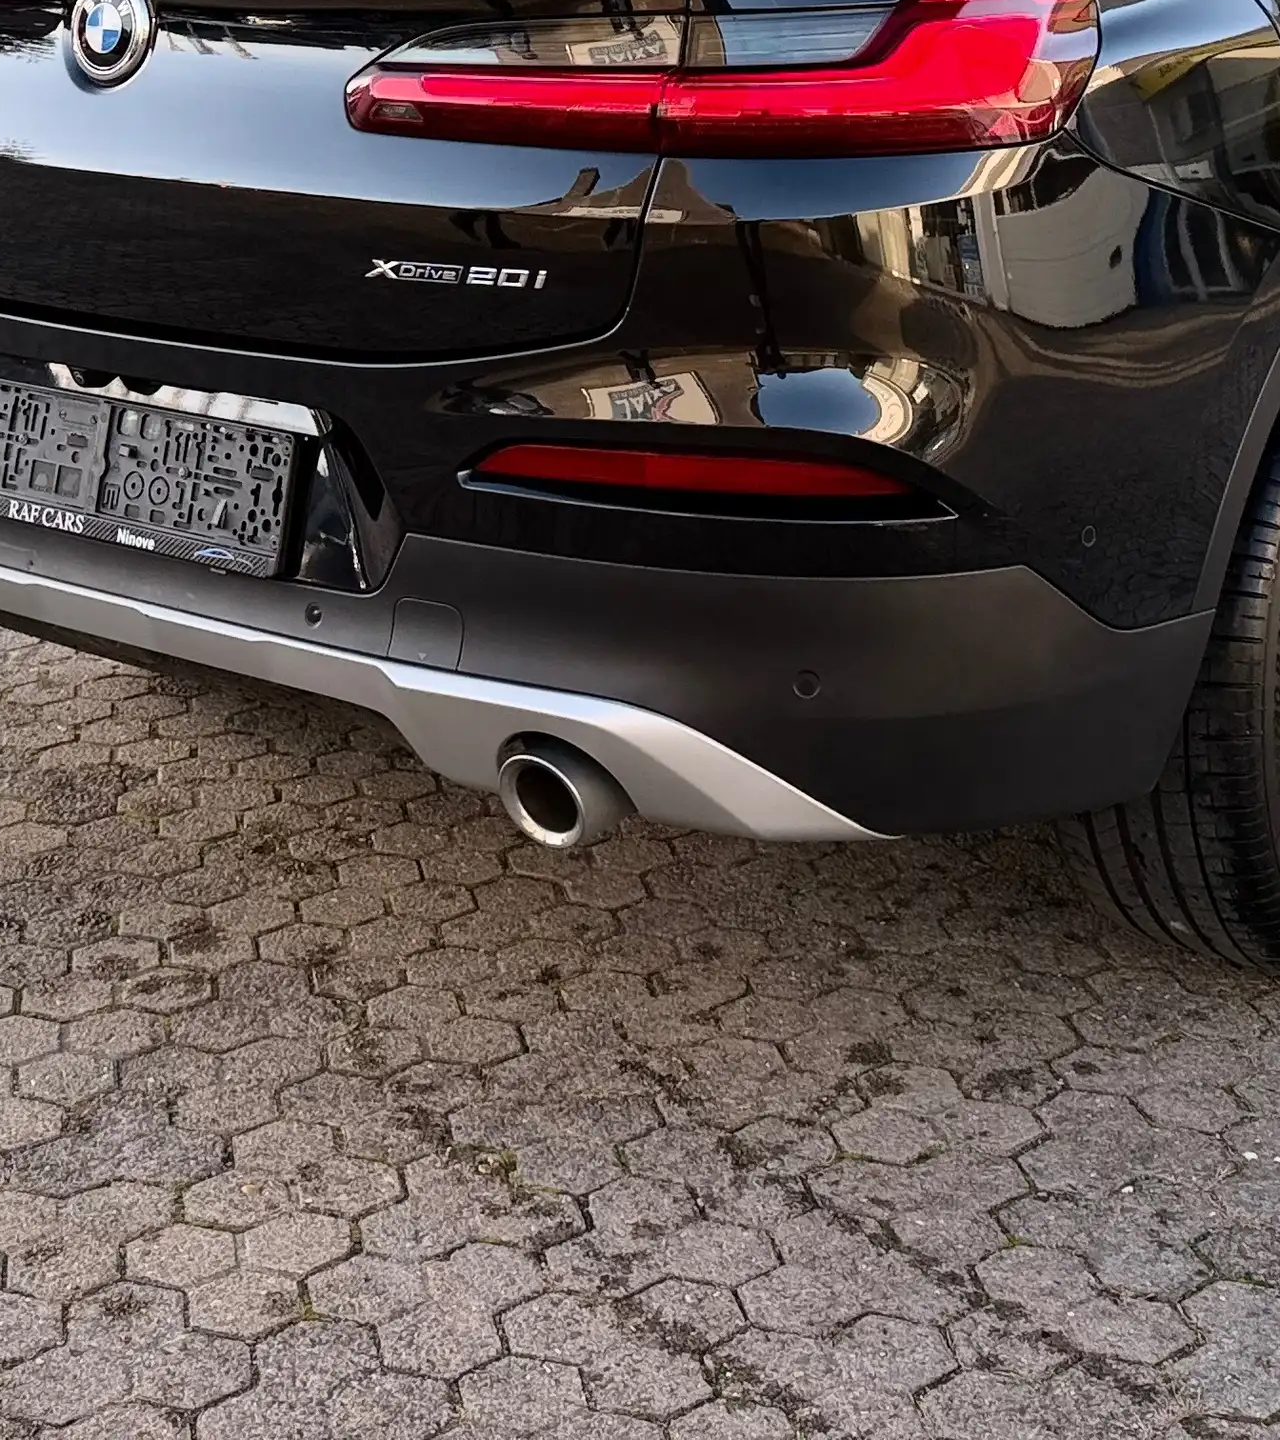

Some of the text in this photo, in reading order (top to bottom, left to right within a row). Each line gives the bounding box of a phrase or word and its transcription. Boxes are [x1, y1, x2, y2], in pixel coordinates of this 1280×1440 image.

[8, 499, 156, 551] RAF CARS Ninove
